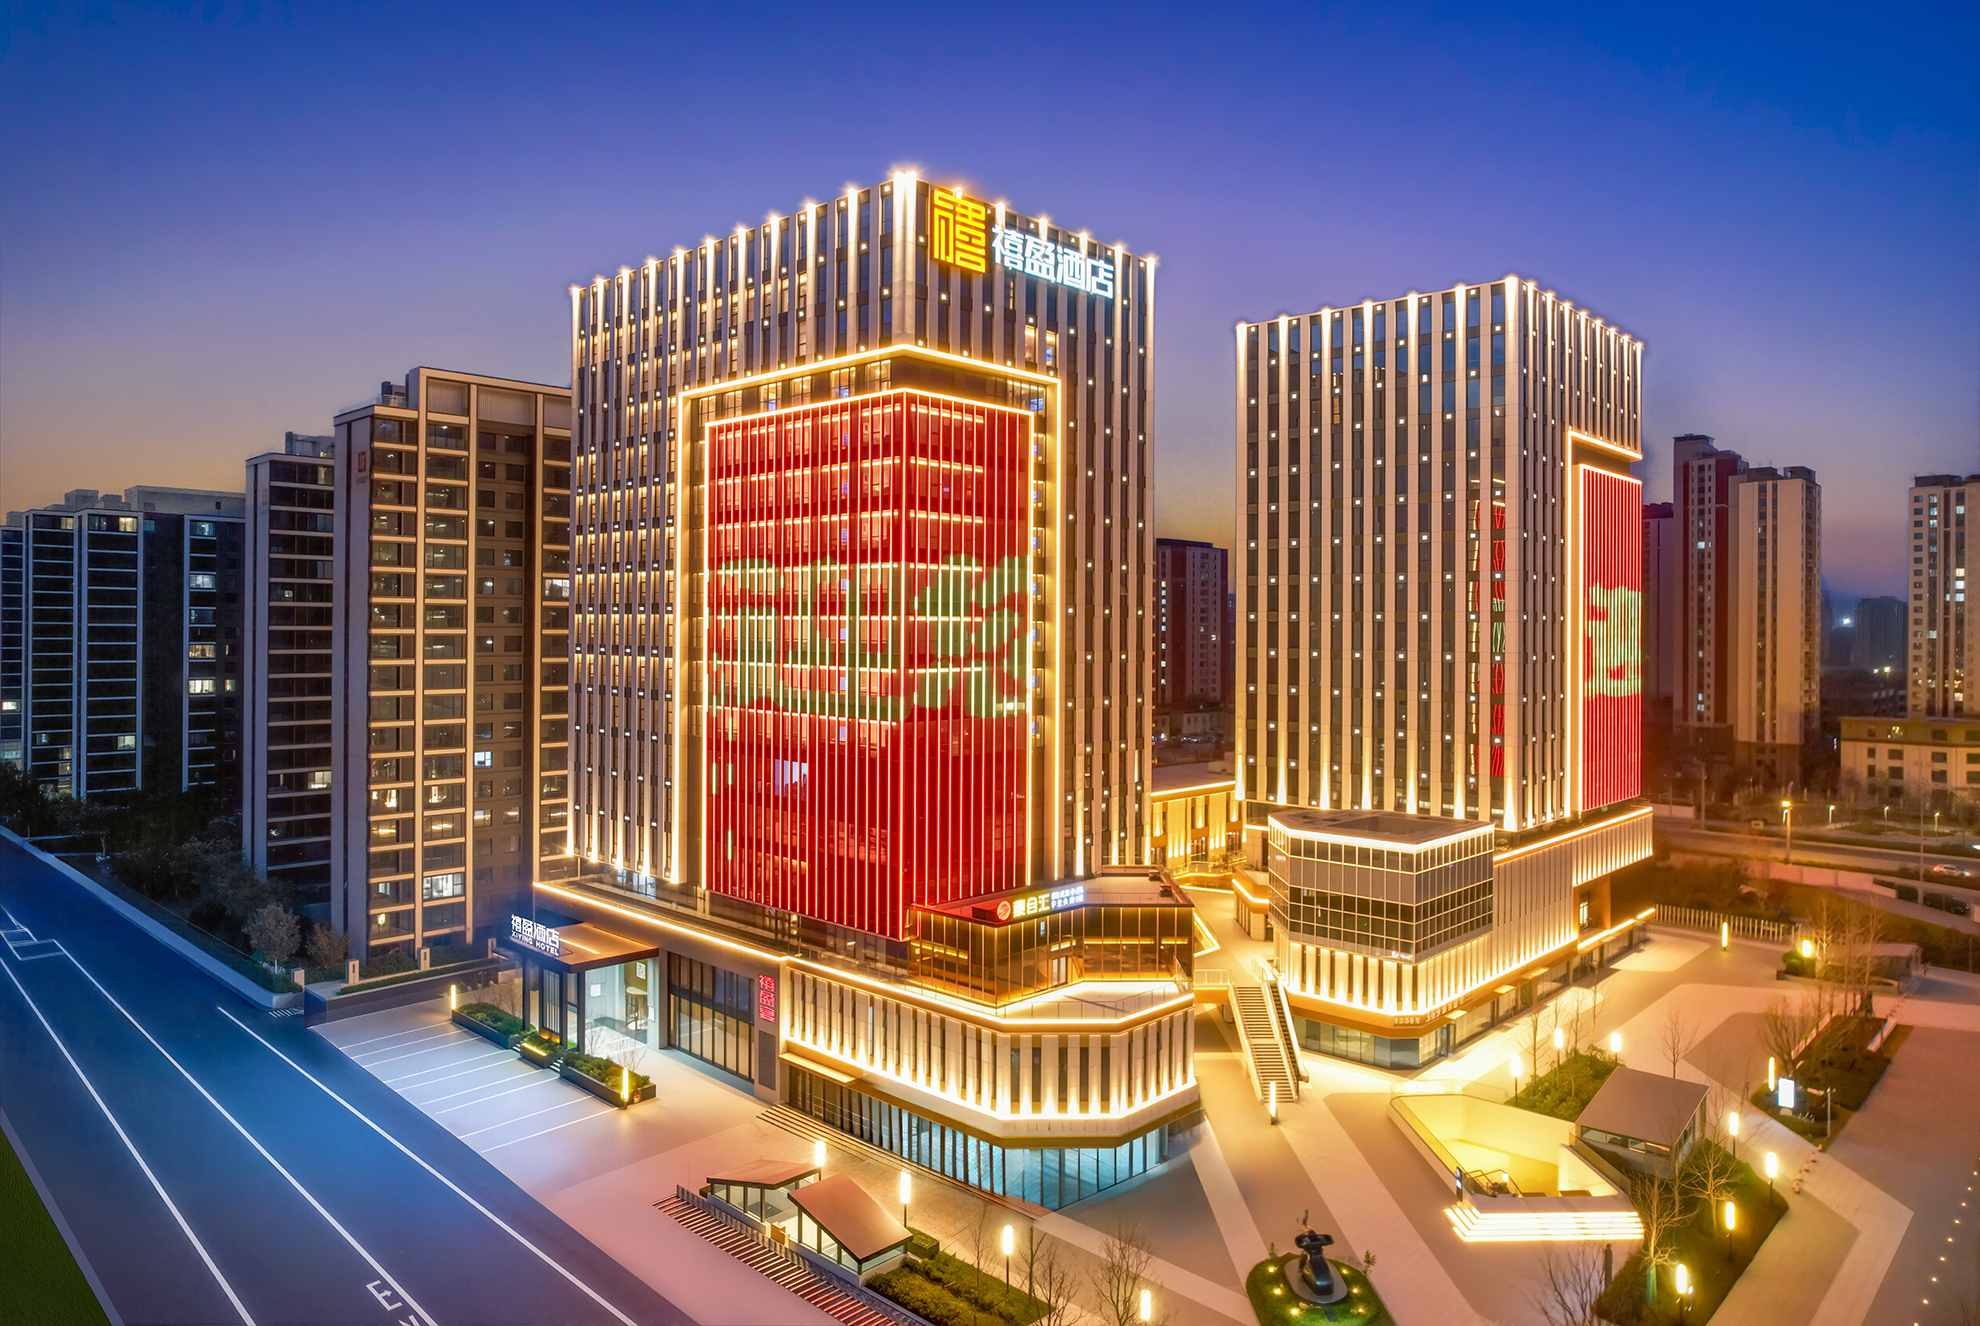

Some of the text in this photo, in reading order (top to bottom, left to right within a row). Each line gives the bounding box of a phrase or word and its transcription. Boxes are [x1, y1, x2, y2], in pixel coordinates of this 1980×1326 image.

[991, 224, 1115, 299] 禧盈酒店
[511, 914, 560, 949] 禧盈酒店
[511, 930, 560, 957] XIYING HOTEL
